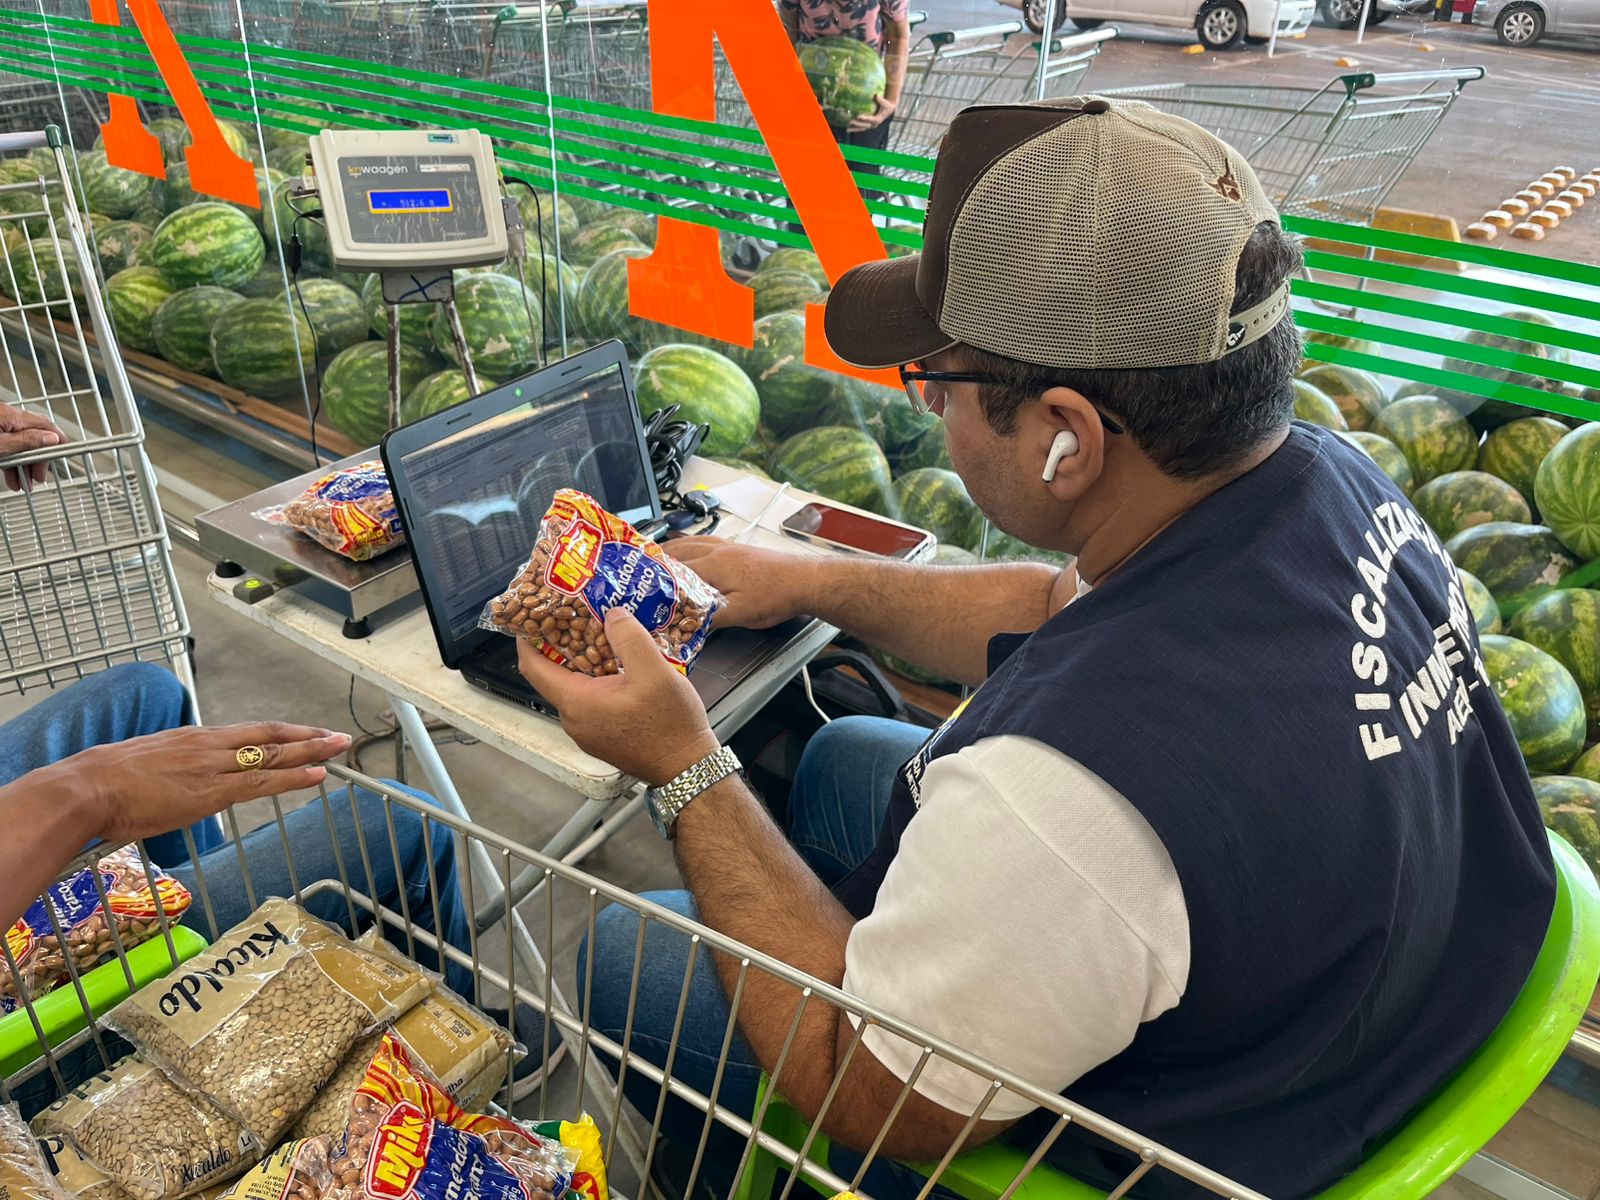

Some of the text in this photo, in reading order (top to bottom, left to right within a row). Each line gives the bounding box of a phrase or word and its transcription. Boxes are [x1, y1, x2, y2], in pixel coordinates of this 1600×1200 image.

[623, 568, 655, 614] Branco
[1399, 581, 1470, 739] INMETRO
[158, 921, 290, 1017] Kicaldo
[429, 1022, 458, 1053] Lentilha
[375, 1113, 425, 1190] Mik
